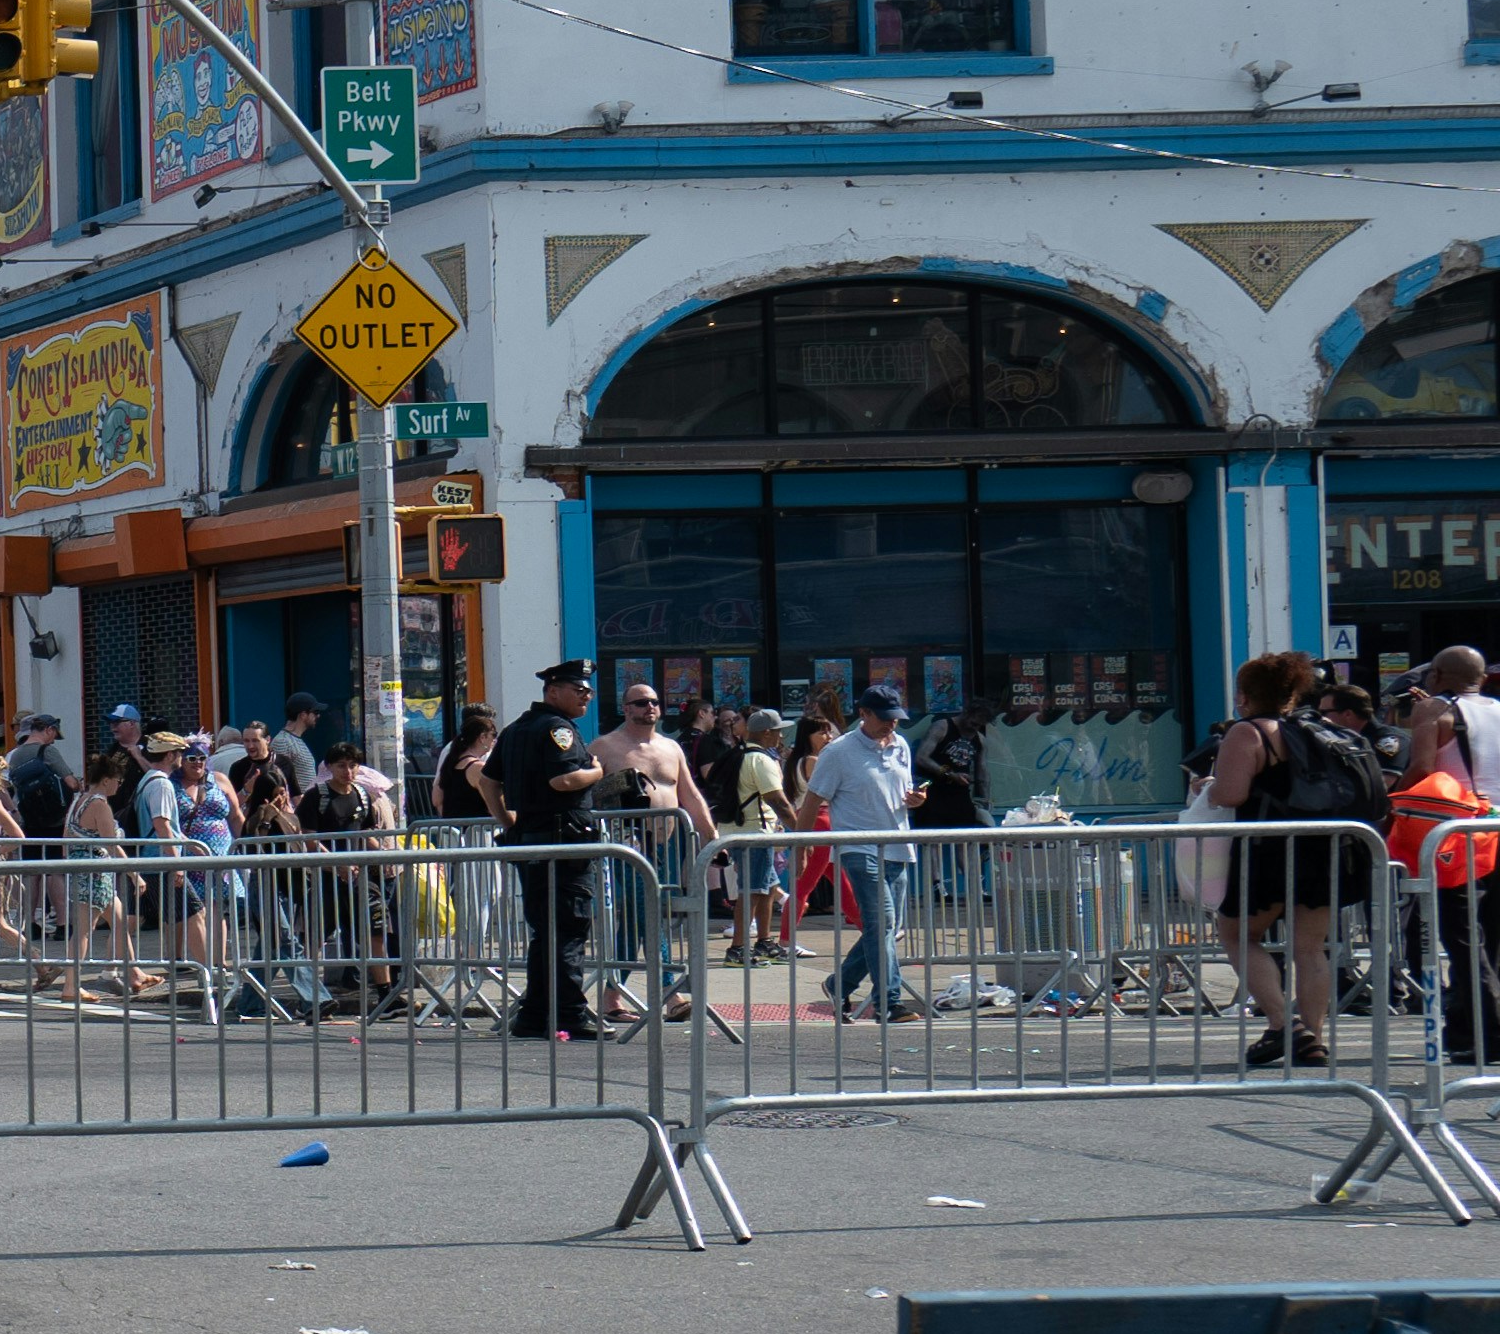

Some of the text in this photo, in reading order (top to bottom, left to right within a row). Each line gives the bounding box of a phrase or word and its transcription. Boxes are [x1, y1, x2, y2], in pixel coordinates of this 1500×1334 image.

[346, 81, 391, 103] Belt
[338, 111, 401, 137] Pkwy
[356, 282, 396, 309] NO
[319, 322, 436, 351] OUTLET
[16, 358, 62, 422] CONEY
[408, 405, 471, 435] Surf Av
[15, 410, 94, 458] ENTERTAINMENT
[26, 439, 73, 475] HISTORY
[346, 448, 355, 473] 12
[36, 463, 61, 487] ART
[437, 484, 472, 498] KEST
[1392, 569, 1441, 588] 1208
[1334, 630, 1352, 650] A
[1012, 695, 1045, 706] CONEY
[1054, 697, 1086, 706] CONEY
[1094, 693, 1127, 704] CONEY
[1136, 695, 1168, 704] CONEY
[1035, 735, 1147, 786] Film
[1423, 971, 1439, 1063] NYPD
